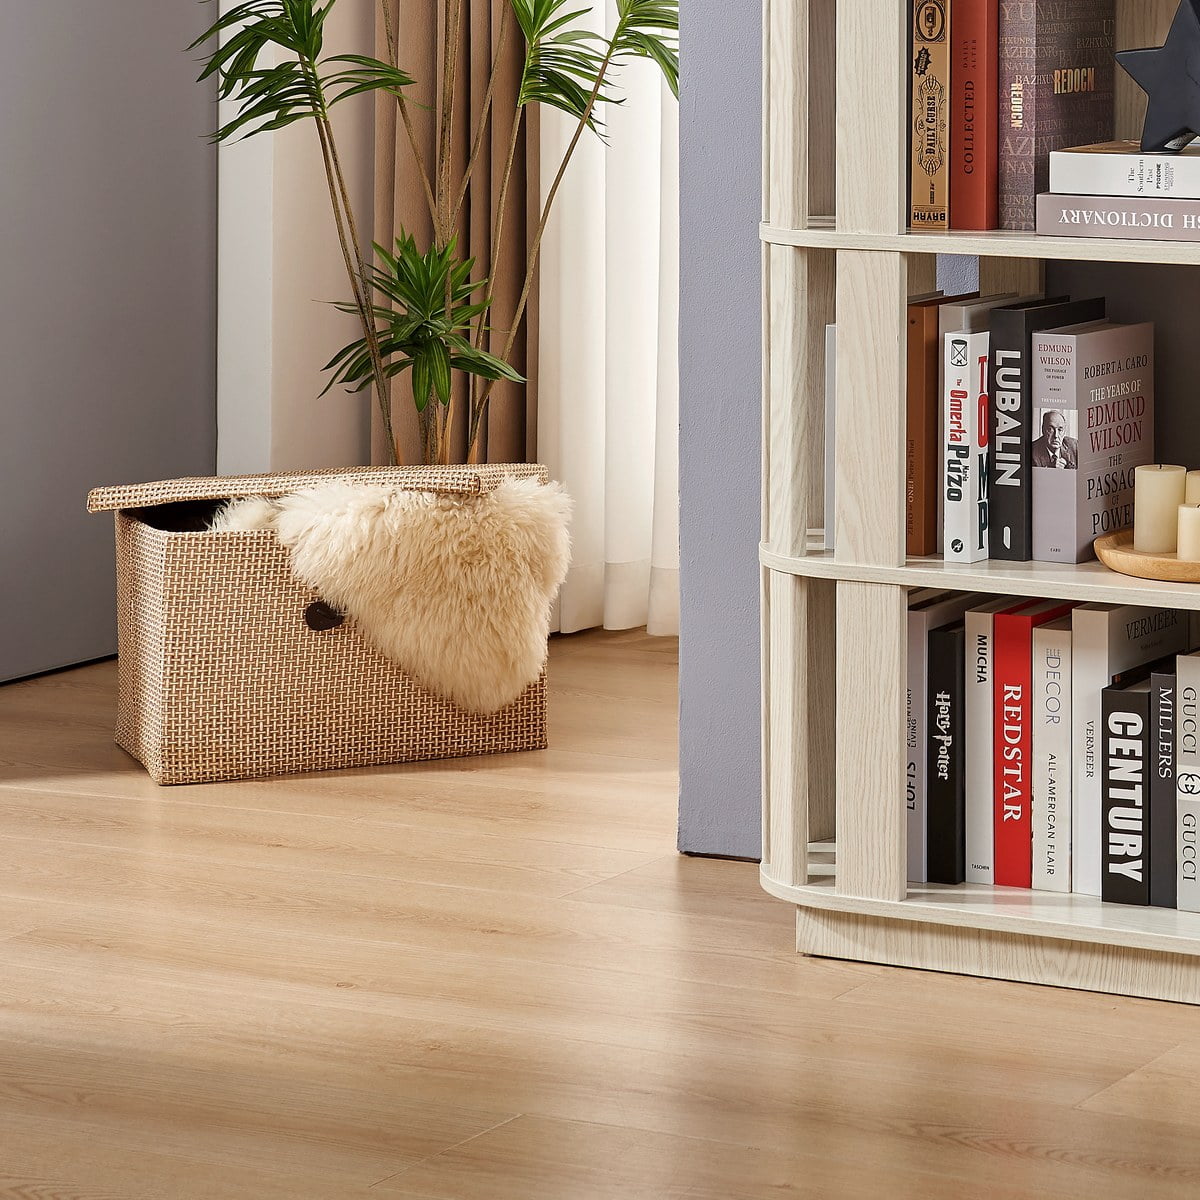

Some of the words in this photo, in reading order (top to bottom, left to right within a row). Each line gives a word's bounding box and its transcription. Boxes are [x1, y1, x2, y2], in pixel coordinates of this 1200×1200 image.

[925, 95, 936, 124] CURSE
[963, 80, 975, 174] COLLECTED
[925, 126, 936, 155] DAILY
[1058, 208, 1173, 228] DICTIONARY
[1038, 343, 1073, 354] EDMUND
[1039, 356, 1072, 366] WILSON
[1084, 360, 1115, 380] ROBERT
[1116, 360, 1125, 373] A.
[1125, 354, 1148, 371] CARO
[1087, 395, 1146, 429] EDMUND
[1090, 386, 1105, 403] THE
[1106, 381, 1130, 399] YEARS
[1130, 379, 1142, 392] OF
[949, 390, 968, 442] Omerta
[995, 350, 1021, 487] LUBALIN
[1089, 420, 1143, 453] WILSON
[947, 444, 970, 502] Puzo
[1108, 453, 1123, 468] THE
[1086, 468, 1135, 500] PASSAG
[1092, 503, 1135, 535] POWE
[976, 634, 987, 683] MUCHA
[934, 690, 951, 734] Harry
[1046, 656, 1061, 725] DECOR
[1158, 686, 1173, 779] MILLERS
[1182, 686, 1197, 756] GUCCI
[932, 735, 952, 781] Potter
[1003, 684, 1022, 822] REDSTAR
[1085, 720, 1094, 778] VERMEER
[1047, 753, 1057, 839] ALL-AMERICAN
[1107, 711, 1143, 883] CENTURY
[1047, 844, 1055, 875] FLAIR
[1182, 812, 1197, 882] GUCCI
